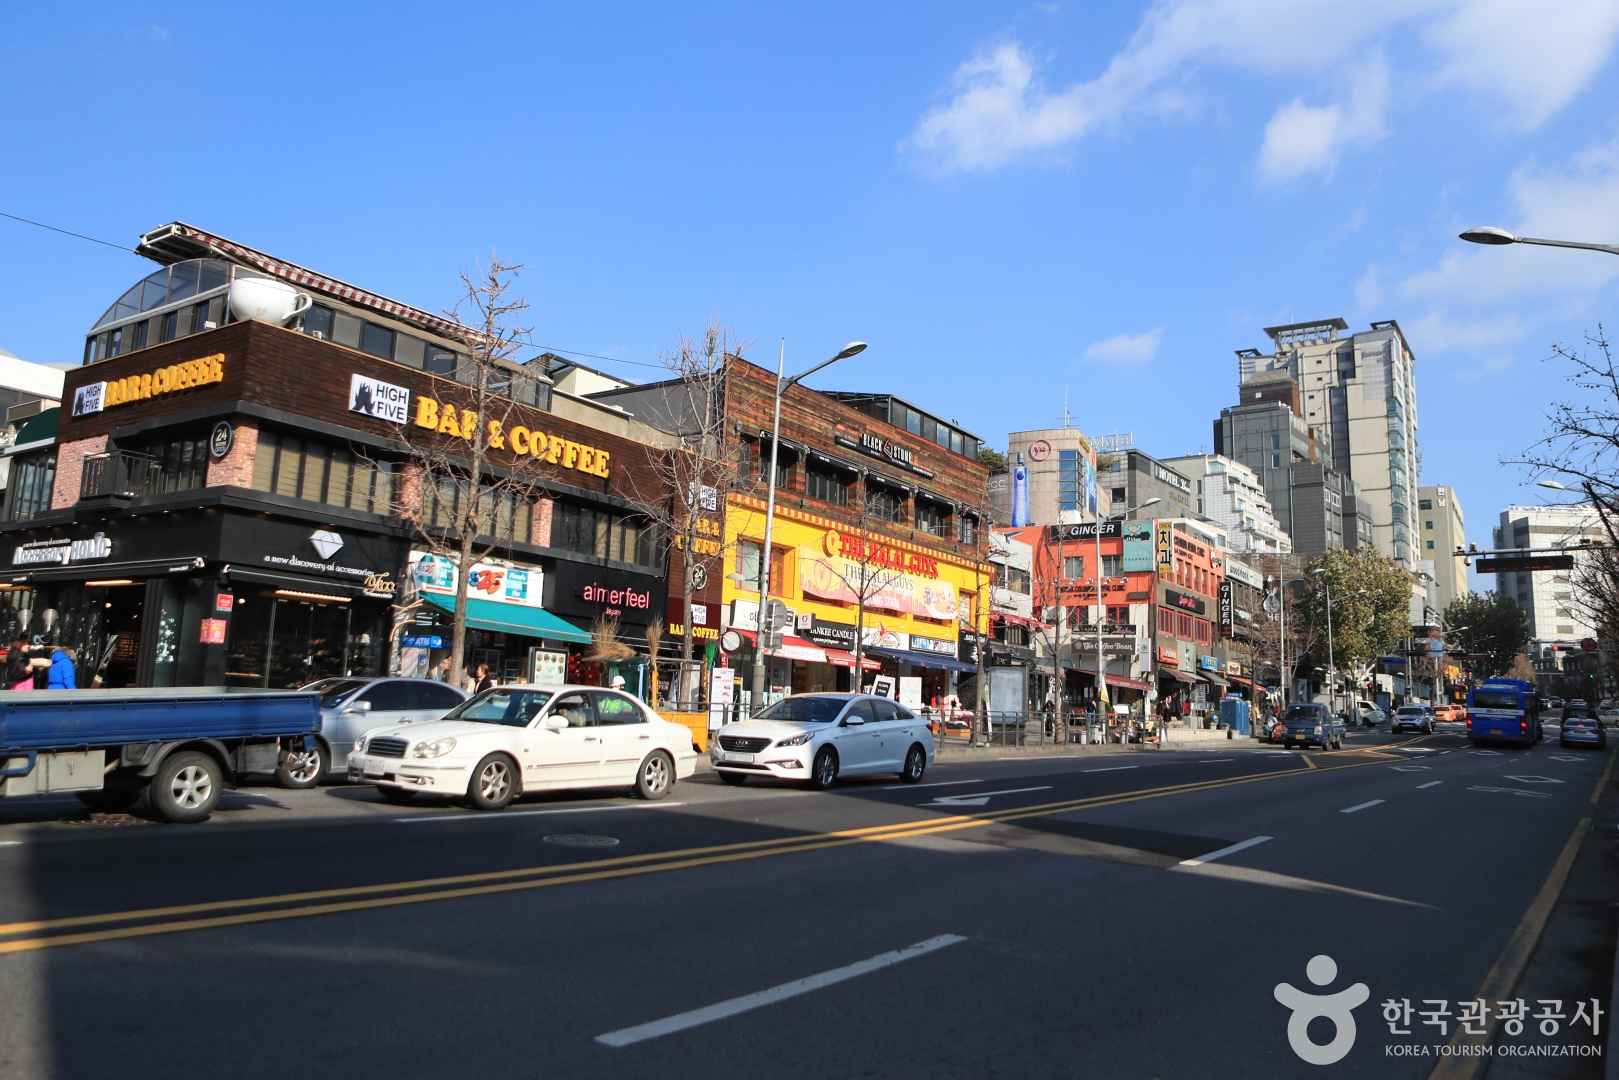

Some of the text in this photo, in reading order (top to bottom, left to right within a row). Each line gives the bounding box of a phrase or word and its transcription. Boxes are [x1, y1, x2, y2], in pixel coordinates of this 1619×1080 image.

[86, 384, 103, 396] HIGH
[375, 384, 407, 405] HIGH
[85, 398, 101, 410] FIVE
[376, 401, 406, 420] FIVE
[216, 428, 227, 441] 24
[487, 420, 505, 450] &
[510, 426, 610, 478] COFFEE
[863, 433, 883, 452] BLACK
[893, 445, 913, 464] STONE
[1071, 523, 1115, 536] GINGER
[840, 534, 865, 559] THE
[908, 551, 939, 577] GUYS
[1160, 529, 1171, 566] 치과
[272, 556, 289, 565] new
[290, 555, 326, 572] discovery
[327, 561, 336, 572] of
[583, 582, 650, 609] aimerfeel
[1221, 585, 1231, 625] GINGER
[692, 627, 720, 640] COFFEE
[832, 629, 855, 640] CANDLE
